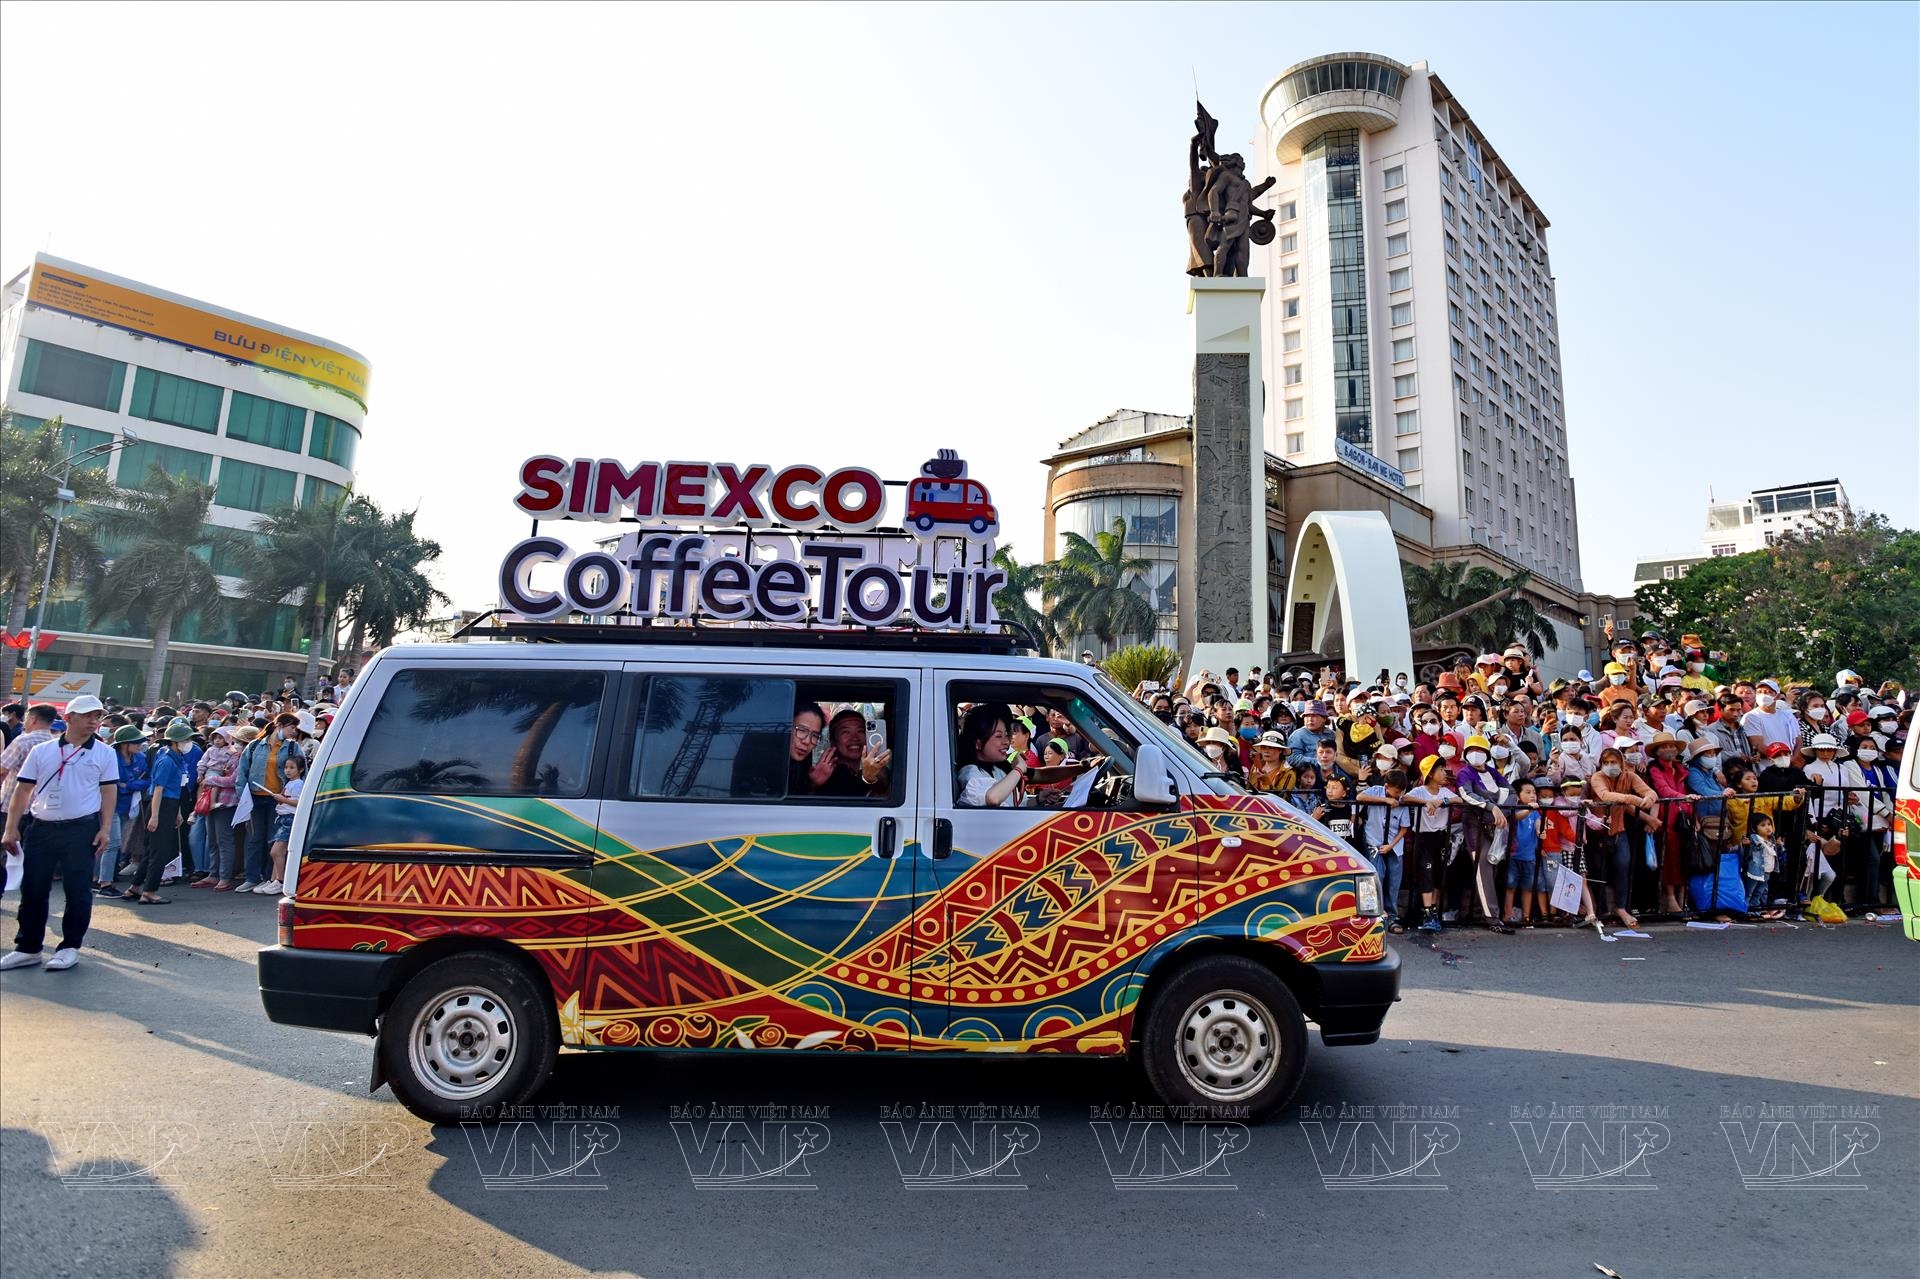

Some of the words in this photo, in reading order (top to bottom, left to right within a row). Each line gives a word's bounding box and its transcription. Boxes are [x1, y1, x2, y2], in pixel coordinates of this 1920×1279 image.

[214, 330, 256, 350] BƯU
[310, 357, 344, 376] VIỆT
[514, 455, 887, 531] SIMEXCO
[1388, 470, 1405, 487] HOTEL
